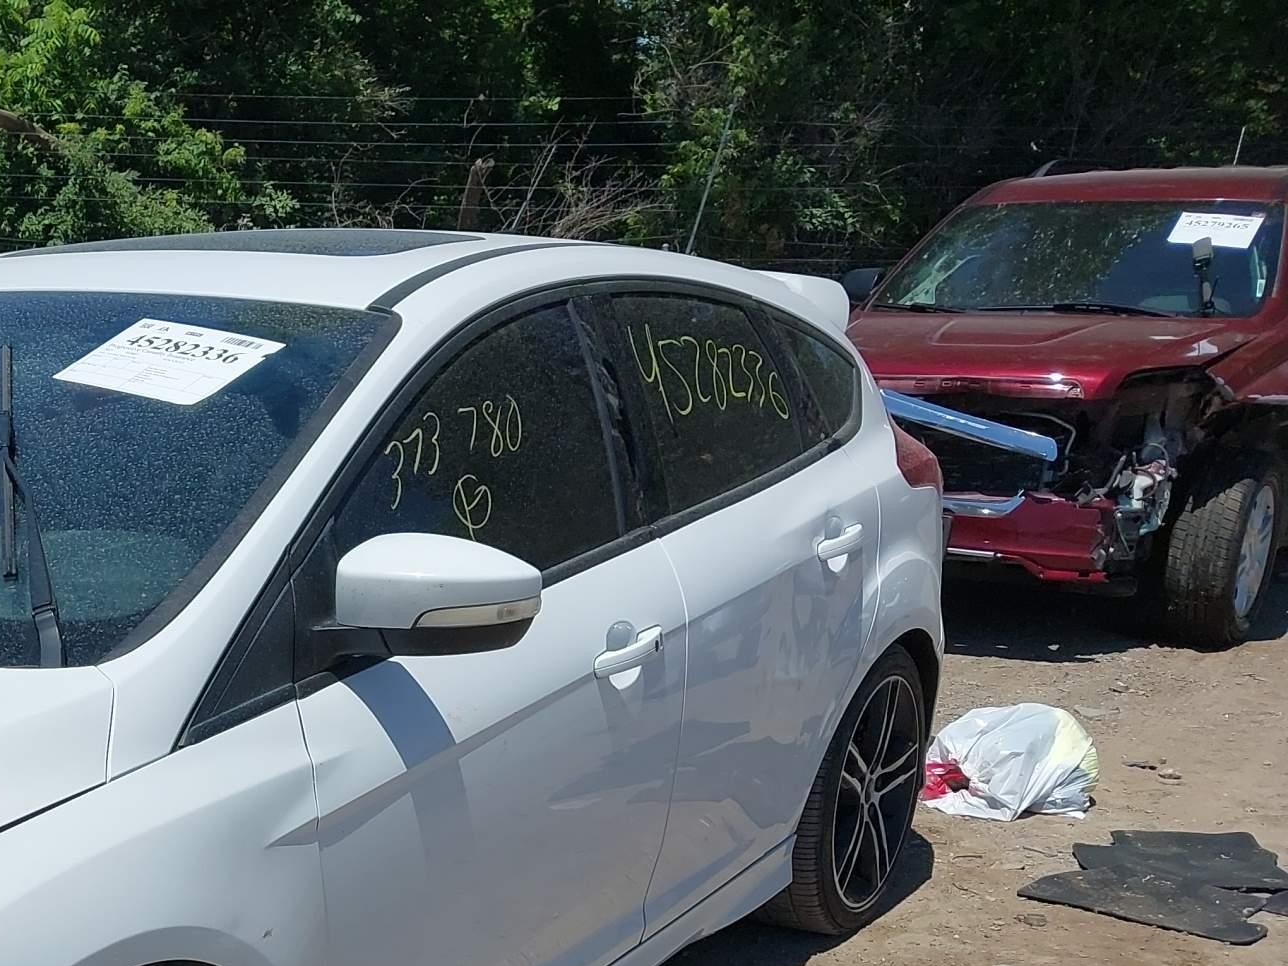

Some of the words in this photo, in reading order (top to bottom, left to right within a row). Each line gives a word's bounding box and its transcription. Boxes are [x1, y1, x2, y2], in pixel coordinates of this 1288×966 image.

[126, 334, 247, 364] 45282336
[627, 323, 789, 424] 45282336
[384, 412, 440, 510] 373
[457, 394, 522, 457] 780
